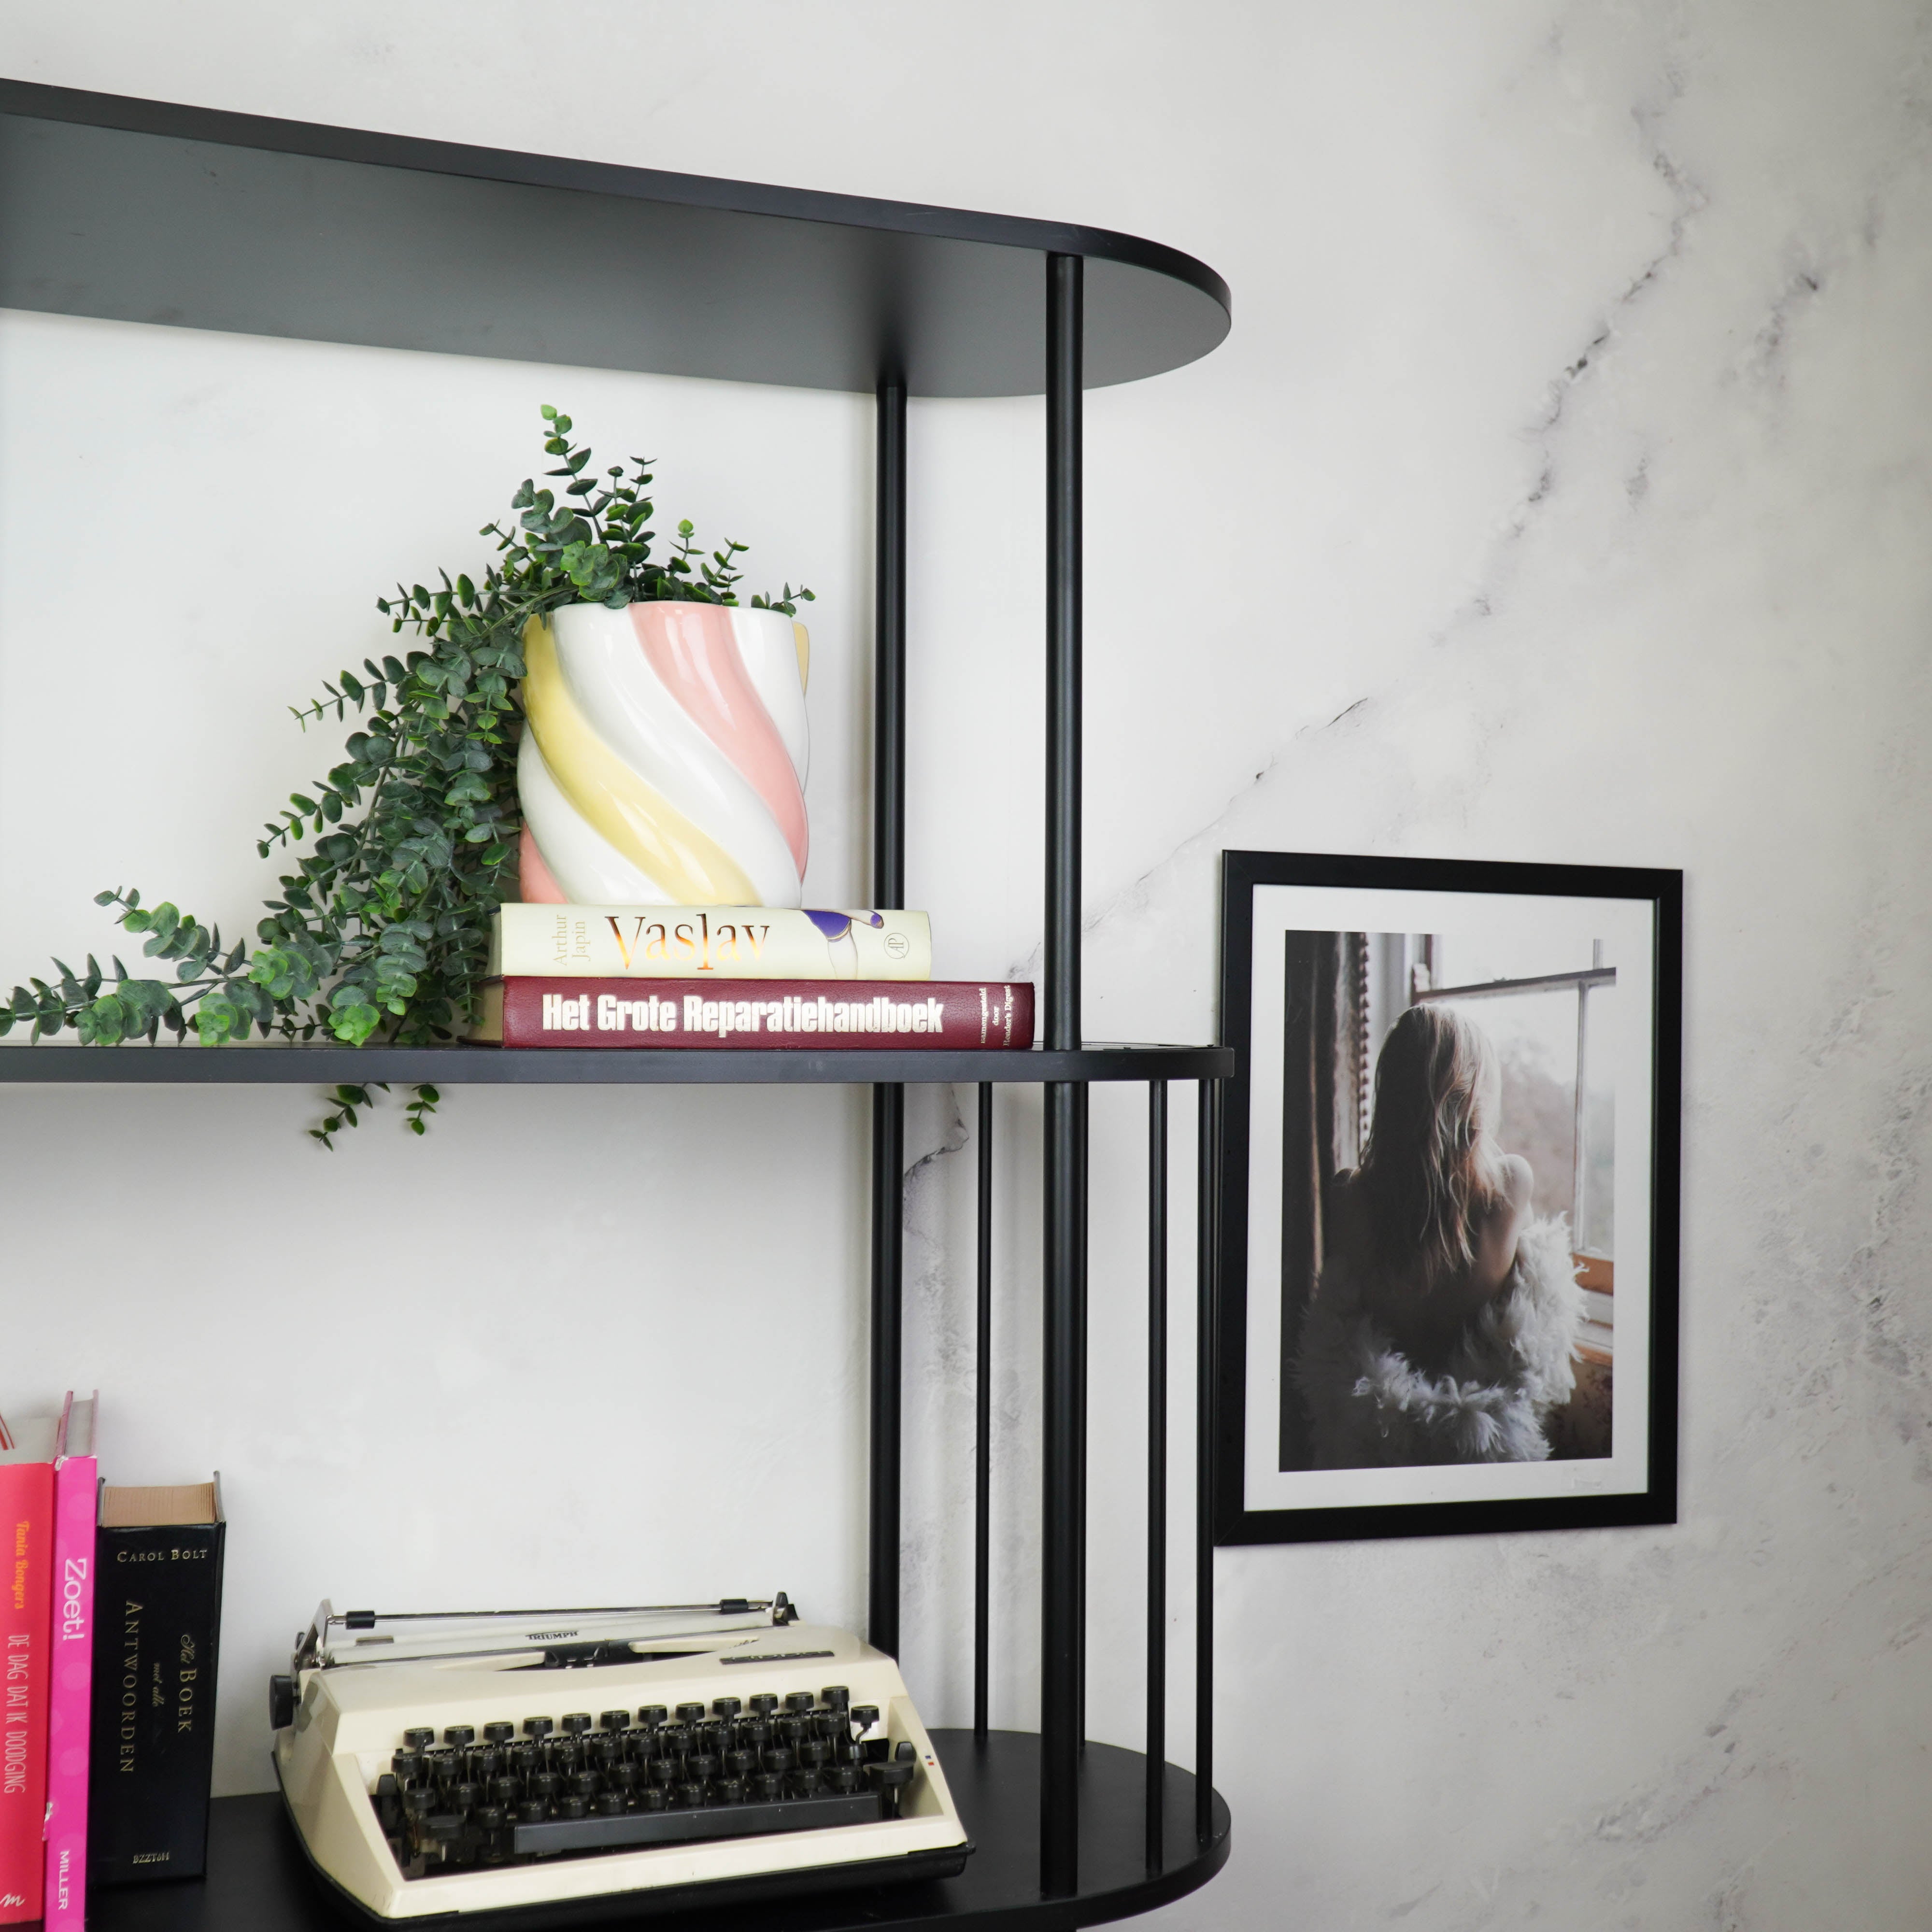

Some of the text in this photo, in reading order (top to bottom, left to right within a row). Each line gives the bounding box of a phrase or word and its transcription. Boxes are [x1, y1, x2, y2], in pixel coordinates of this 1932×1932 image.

[552, 914, 568, 966] Arthur
[571, 921, 591, 962] Japin
[604, 913, 770, 971] Vaslav
[542, 994, 943, 1038] Het Grote Reparatiehandboek
[992, 1006, 1000, 1026] door
[1002, 985, 1013, 1046] Reader's Digest
[11, 1520, 30, 1609] Tania Bongers
[63, 1558, 87, 1641] Zoet!
[525, 1630, 580, 1640] TRIUMPH
[4, 1634, 29, 1793] DE DAG DAT IK DOODGING
[120, 1600, 143, 1773] ANTWOORDEN
[152, 1662, 165, 1708] met alle
[178, 1668, 197, 1733] BOEK
[58, 1850, 69, 1910] MILLER
